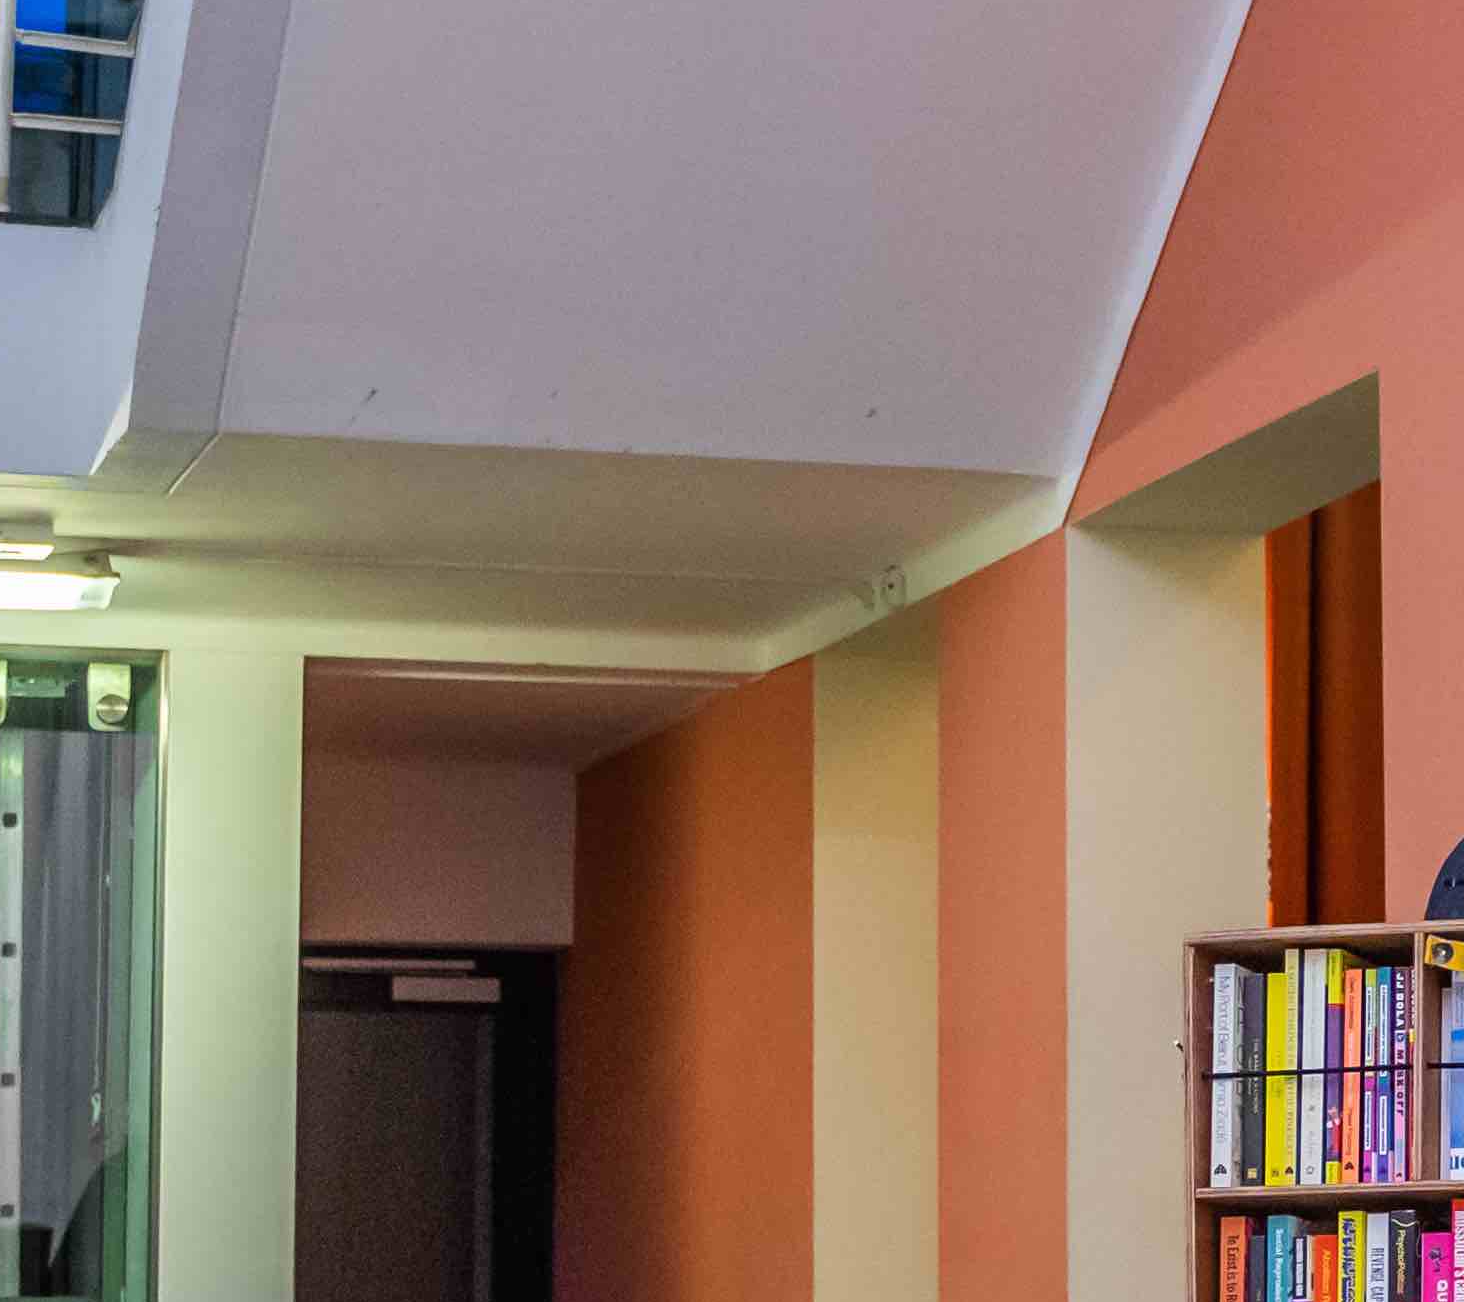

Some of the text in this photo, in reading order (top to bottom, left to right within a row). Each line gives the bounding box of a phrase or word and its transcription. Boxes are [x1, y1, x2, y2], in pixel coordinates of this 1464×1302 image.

[1396, 990, 1404, 1026] BOLA
[1226, 1235, 1238, 1245] To
[1225, 1247, 1238, 1269] Exist
[1369, 1248, 1384, 1283] REVENGE
[1225, 1282, 1237, 1293] to
